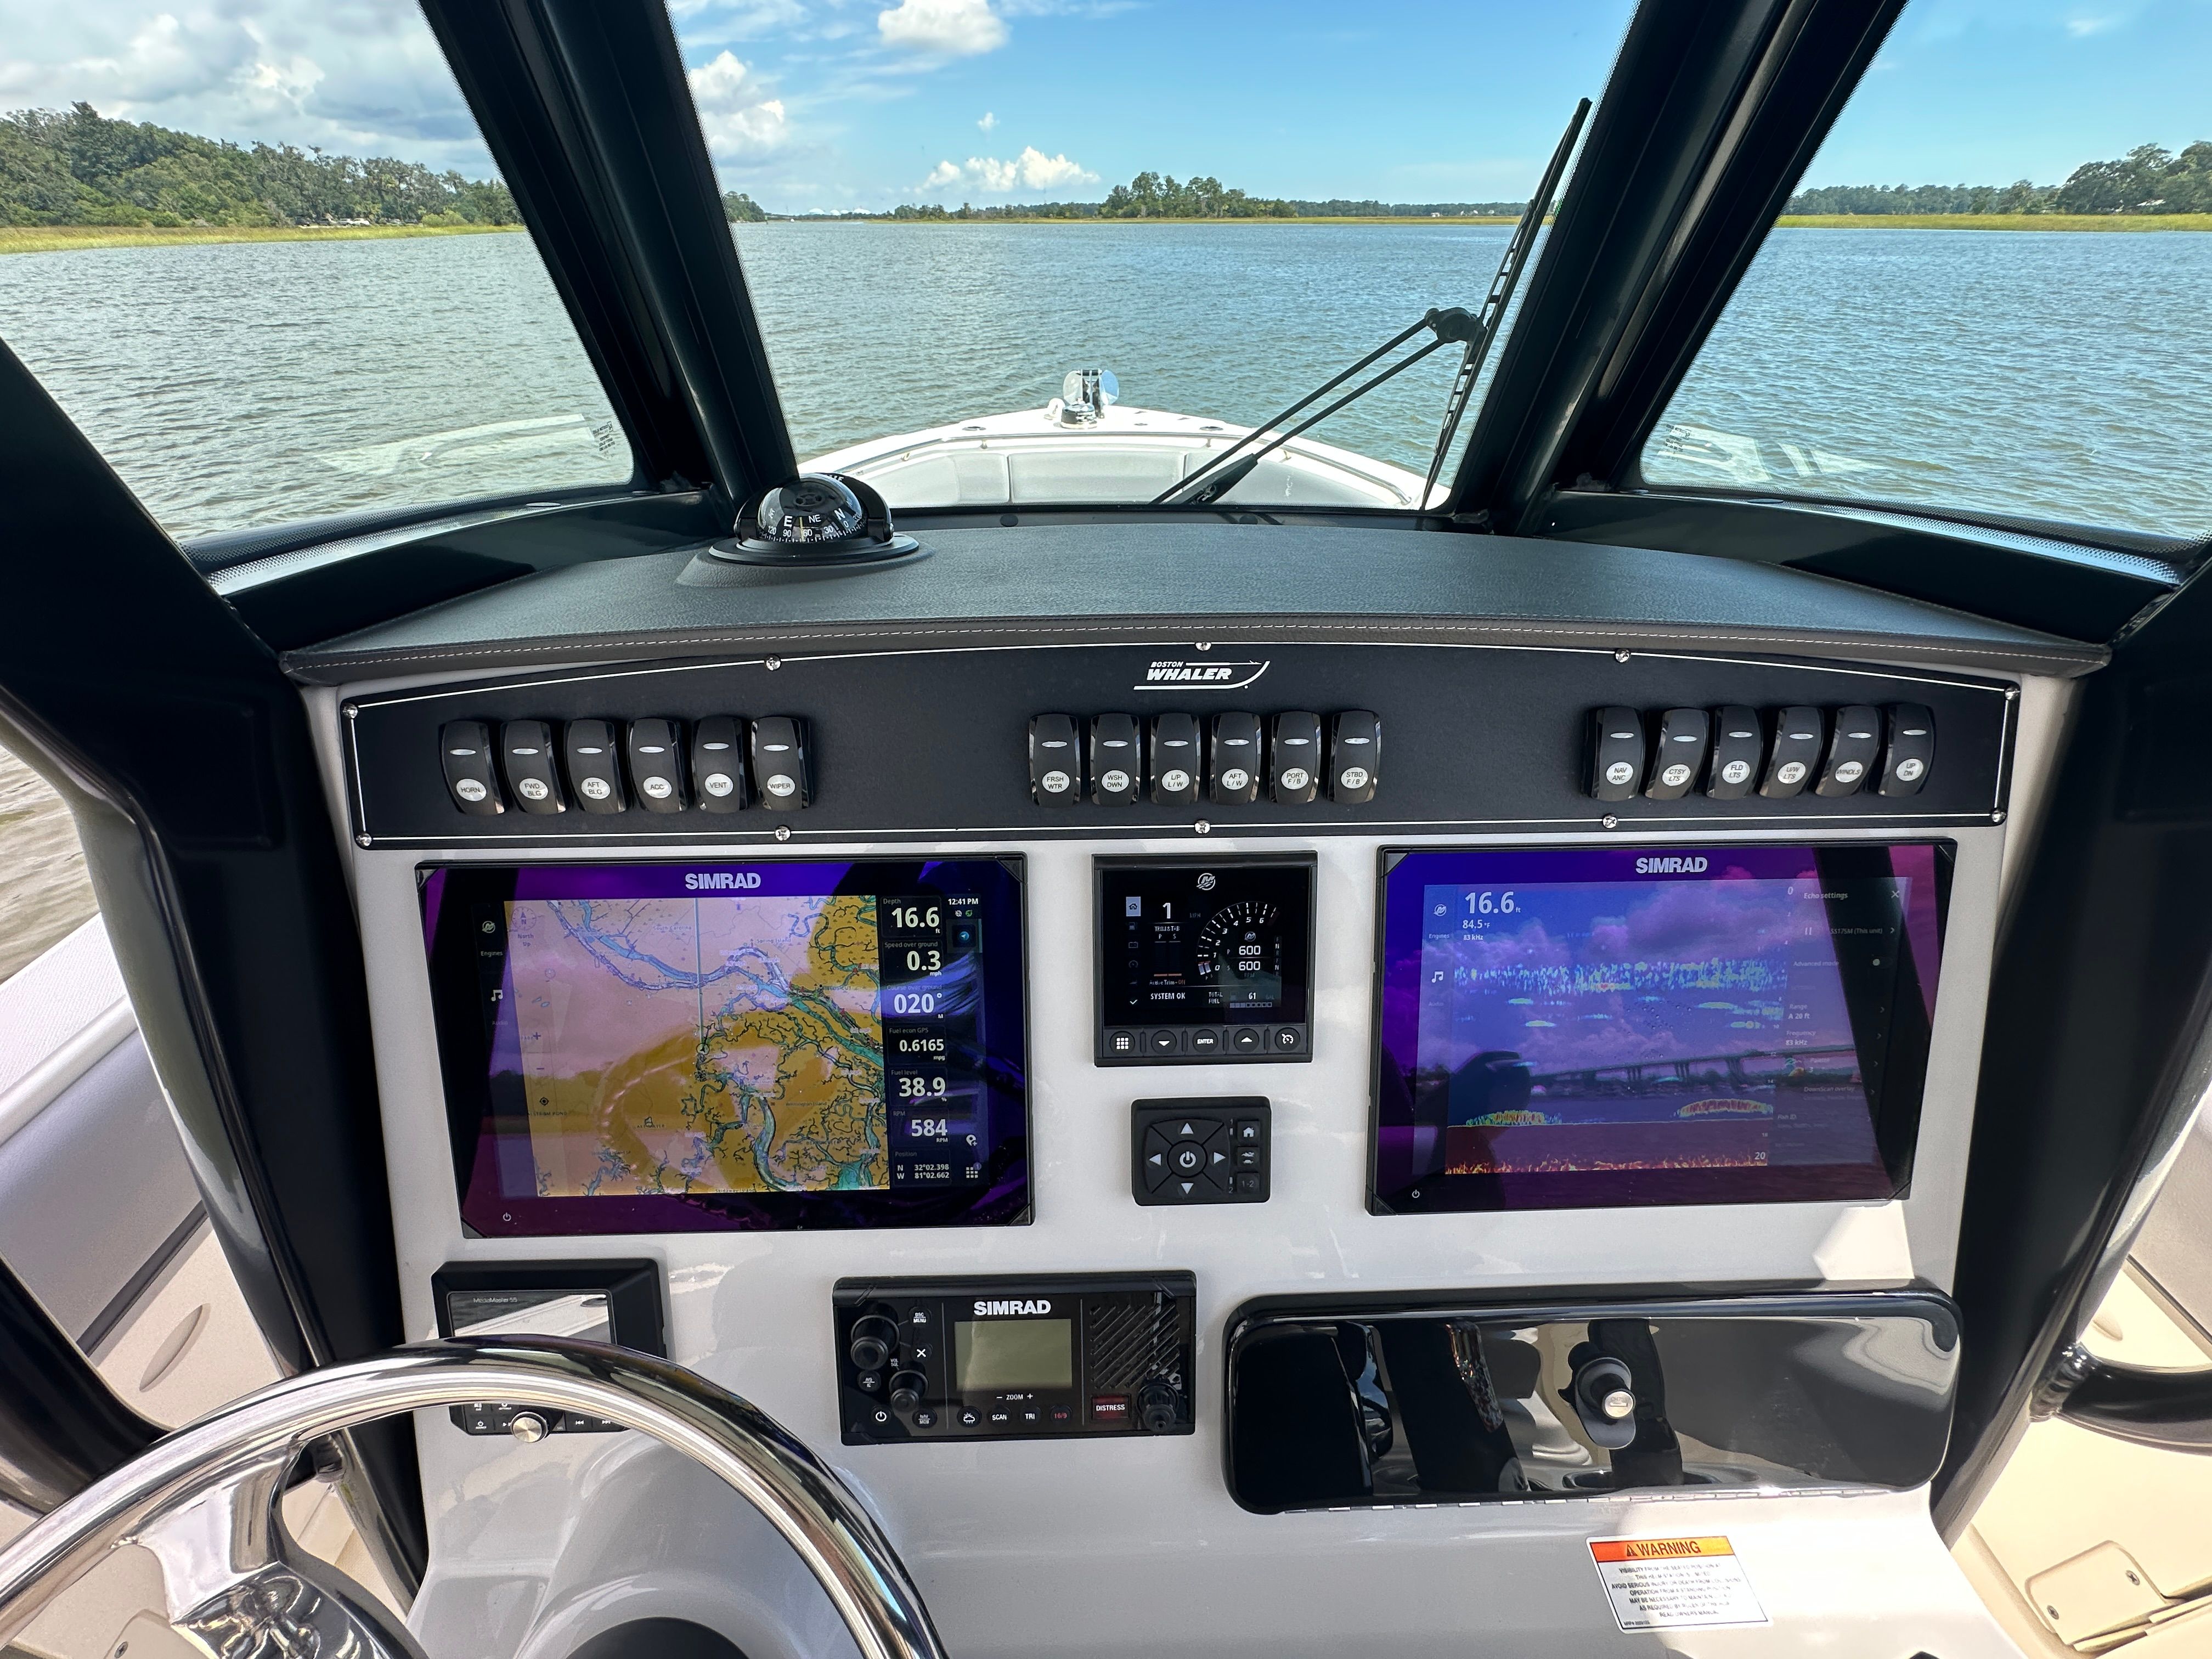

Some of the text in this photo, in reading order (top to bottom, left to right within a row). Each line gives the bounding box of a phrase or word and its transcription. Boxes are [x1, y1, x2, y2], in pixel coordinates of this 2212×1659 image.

[809, 515, 821, 523] NE
[834, 508, 845, 520] N
[784, 516, 793, 527] E
[768, 526, 776, 535] 120
[1147, 668, 1232, 680] WHALER
[1635, 857, 1708, 873] SIMRAD
[685, 873, 761, 889] SIMRAD
[1787, 886, 1793, 895] 0
[1820, 892, 1848, 900] settings
[1465, 891, 1514, 914] 16.6
[1163, 902, 1171, 919] 1
[891, 907, 939, 928] 16.6
[1462, 919, 1483, 928] 84.5
[1239, 945, 1261, 955] 600
[907, 951, 941, 970] 0.3
[1239, 961, 1261, 970] 600
[899, 1039, 944, 1052] 0.6165
[899, 1077, 946, 1097] 38.9
[911, 1119, 948, 1137] 584
[1754, 1152, 1766, 1160] 20
[974, 1300, 1051, 1316] SIMRAD
[1637, 1541, 1701, 1556] WARNING
